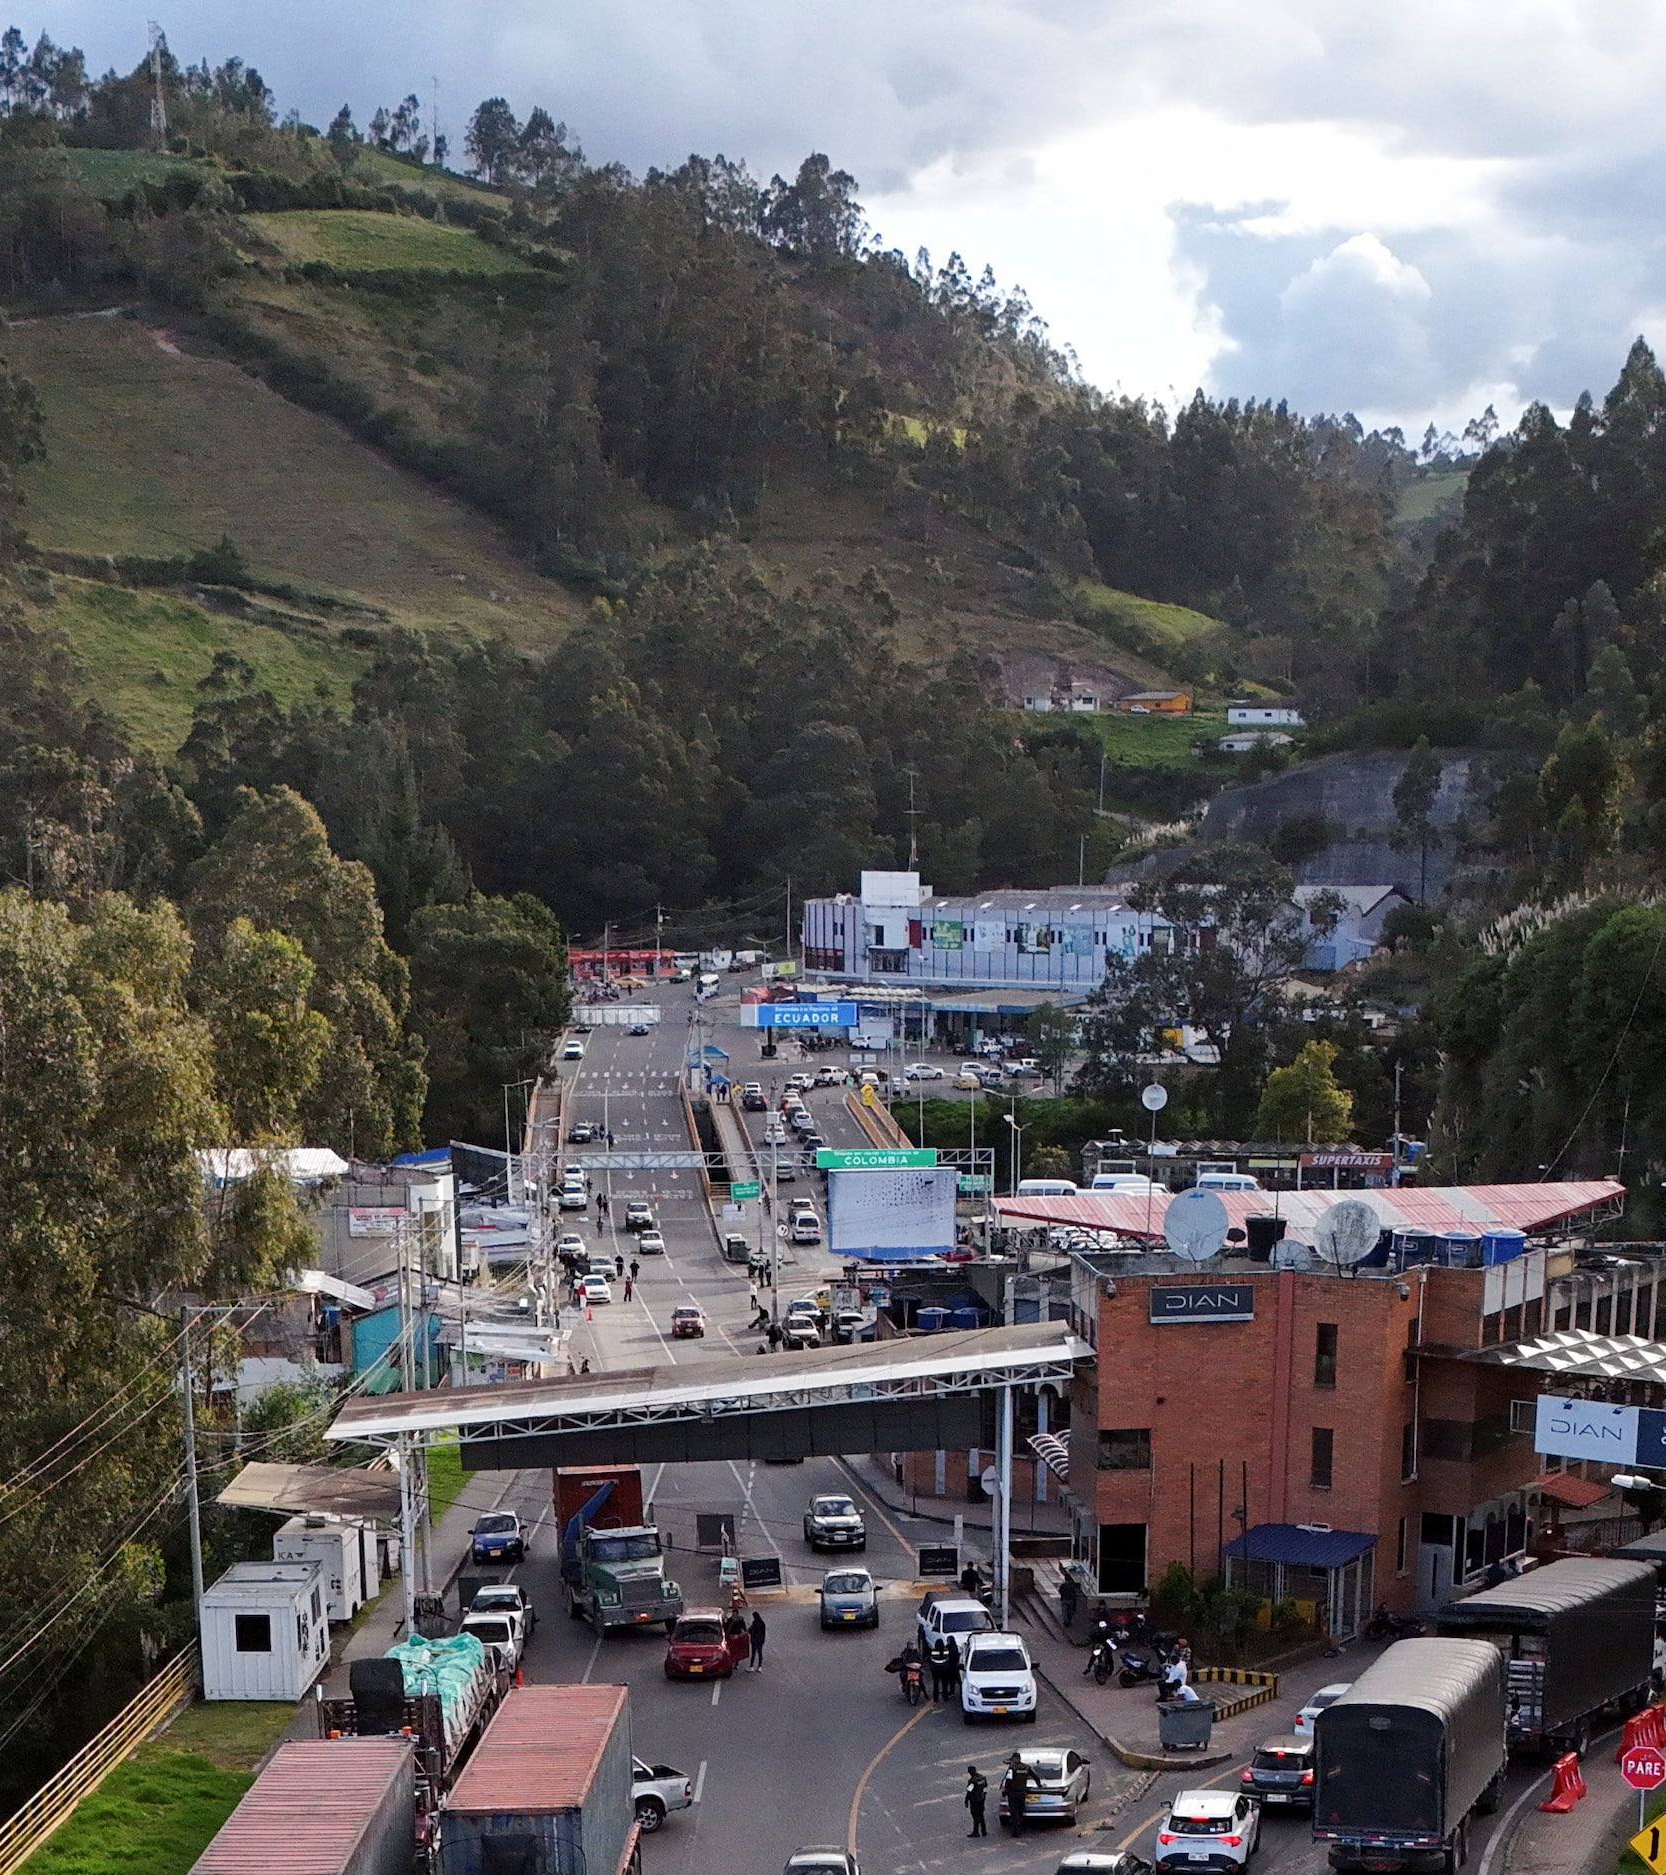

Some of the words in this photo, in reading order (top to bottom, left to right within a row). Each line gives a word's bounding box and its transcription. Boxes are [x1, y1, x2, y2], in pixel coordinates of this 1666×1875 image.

[774, 1013, 839, 1024] ECUADOR
[844, 1156, 909, 1166] COLOMBIA
[1311, 1155, 1382, 1166] SUPERTAXIS
[1166, 1293, 1239, 1309] DIAN
[1550, 1419, 1622, 1441] DIAN
[1627, 1761, 1662, 1776] PARE
